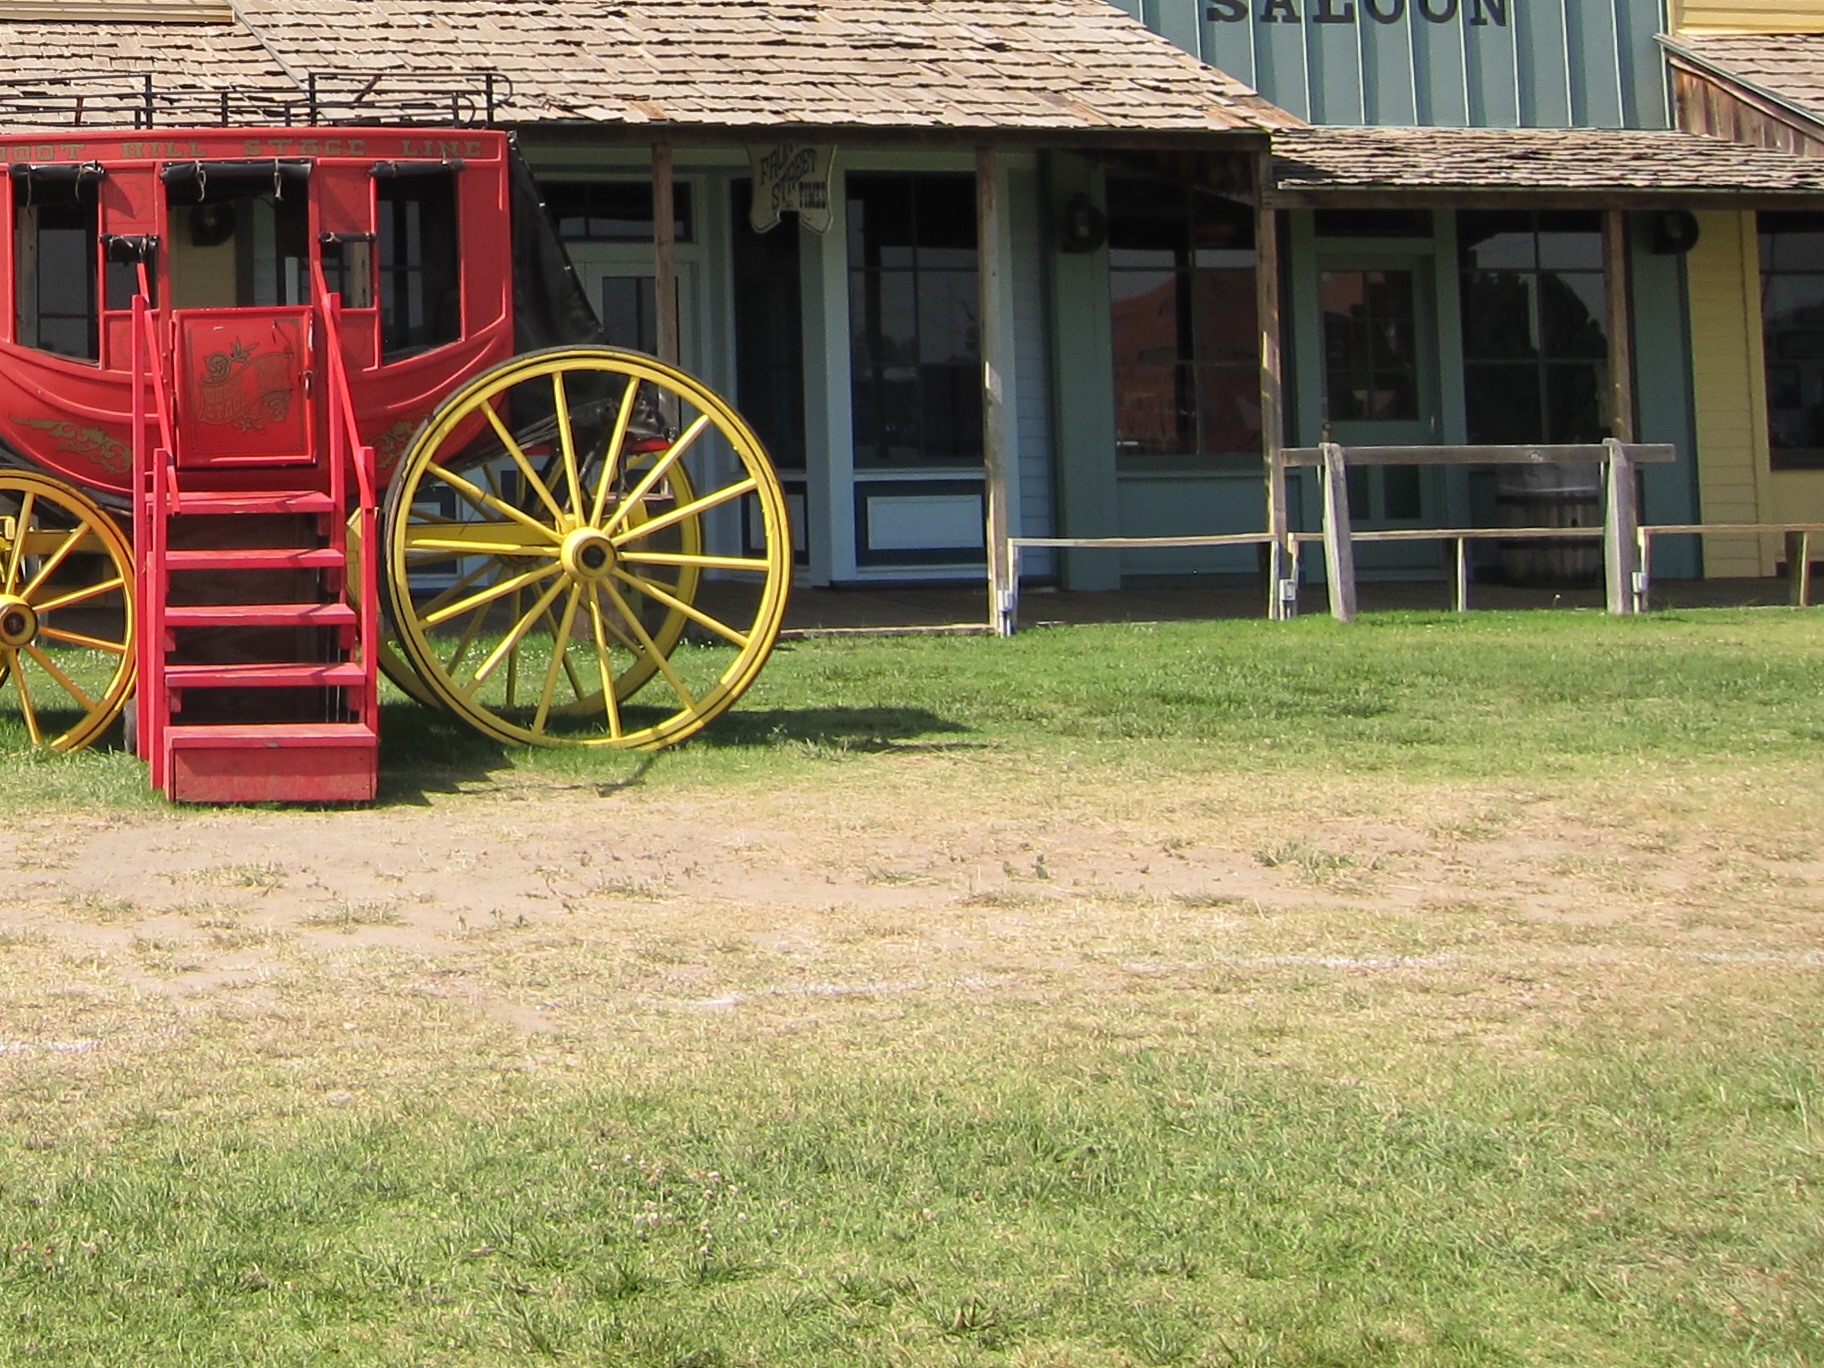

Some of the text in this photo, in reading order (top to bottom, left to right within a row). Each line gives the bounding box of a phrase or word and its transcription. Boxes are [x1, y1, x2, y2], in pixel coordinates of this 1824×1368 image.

[121, 141, 206, 158] HILL
[242, 139, 366, 156] STAGE
[401, 140, 482, 157] LINE
